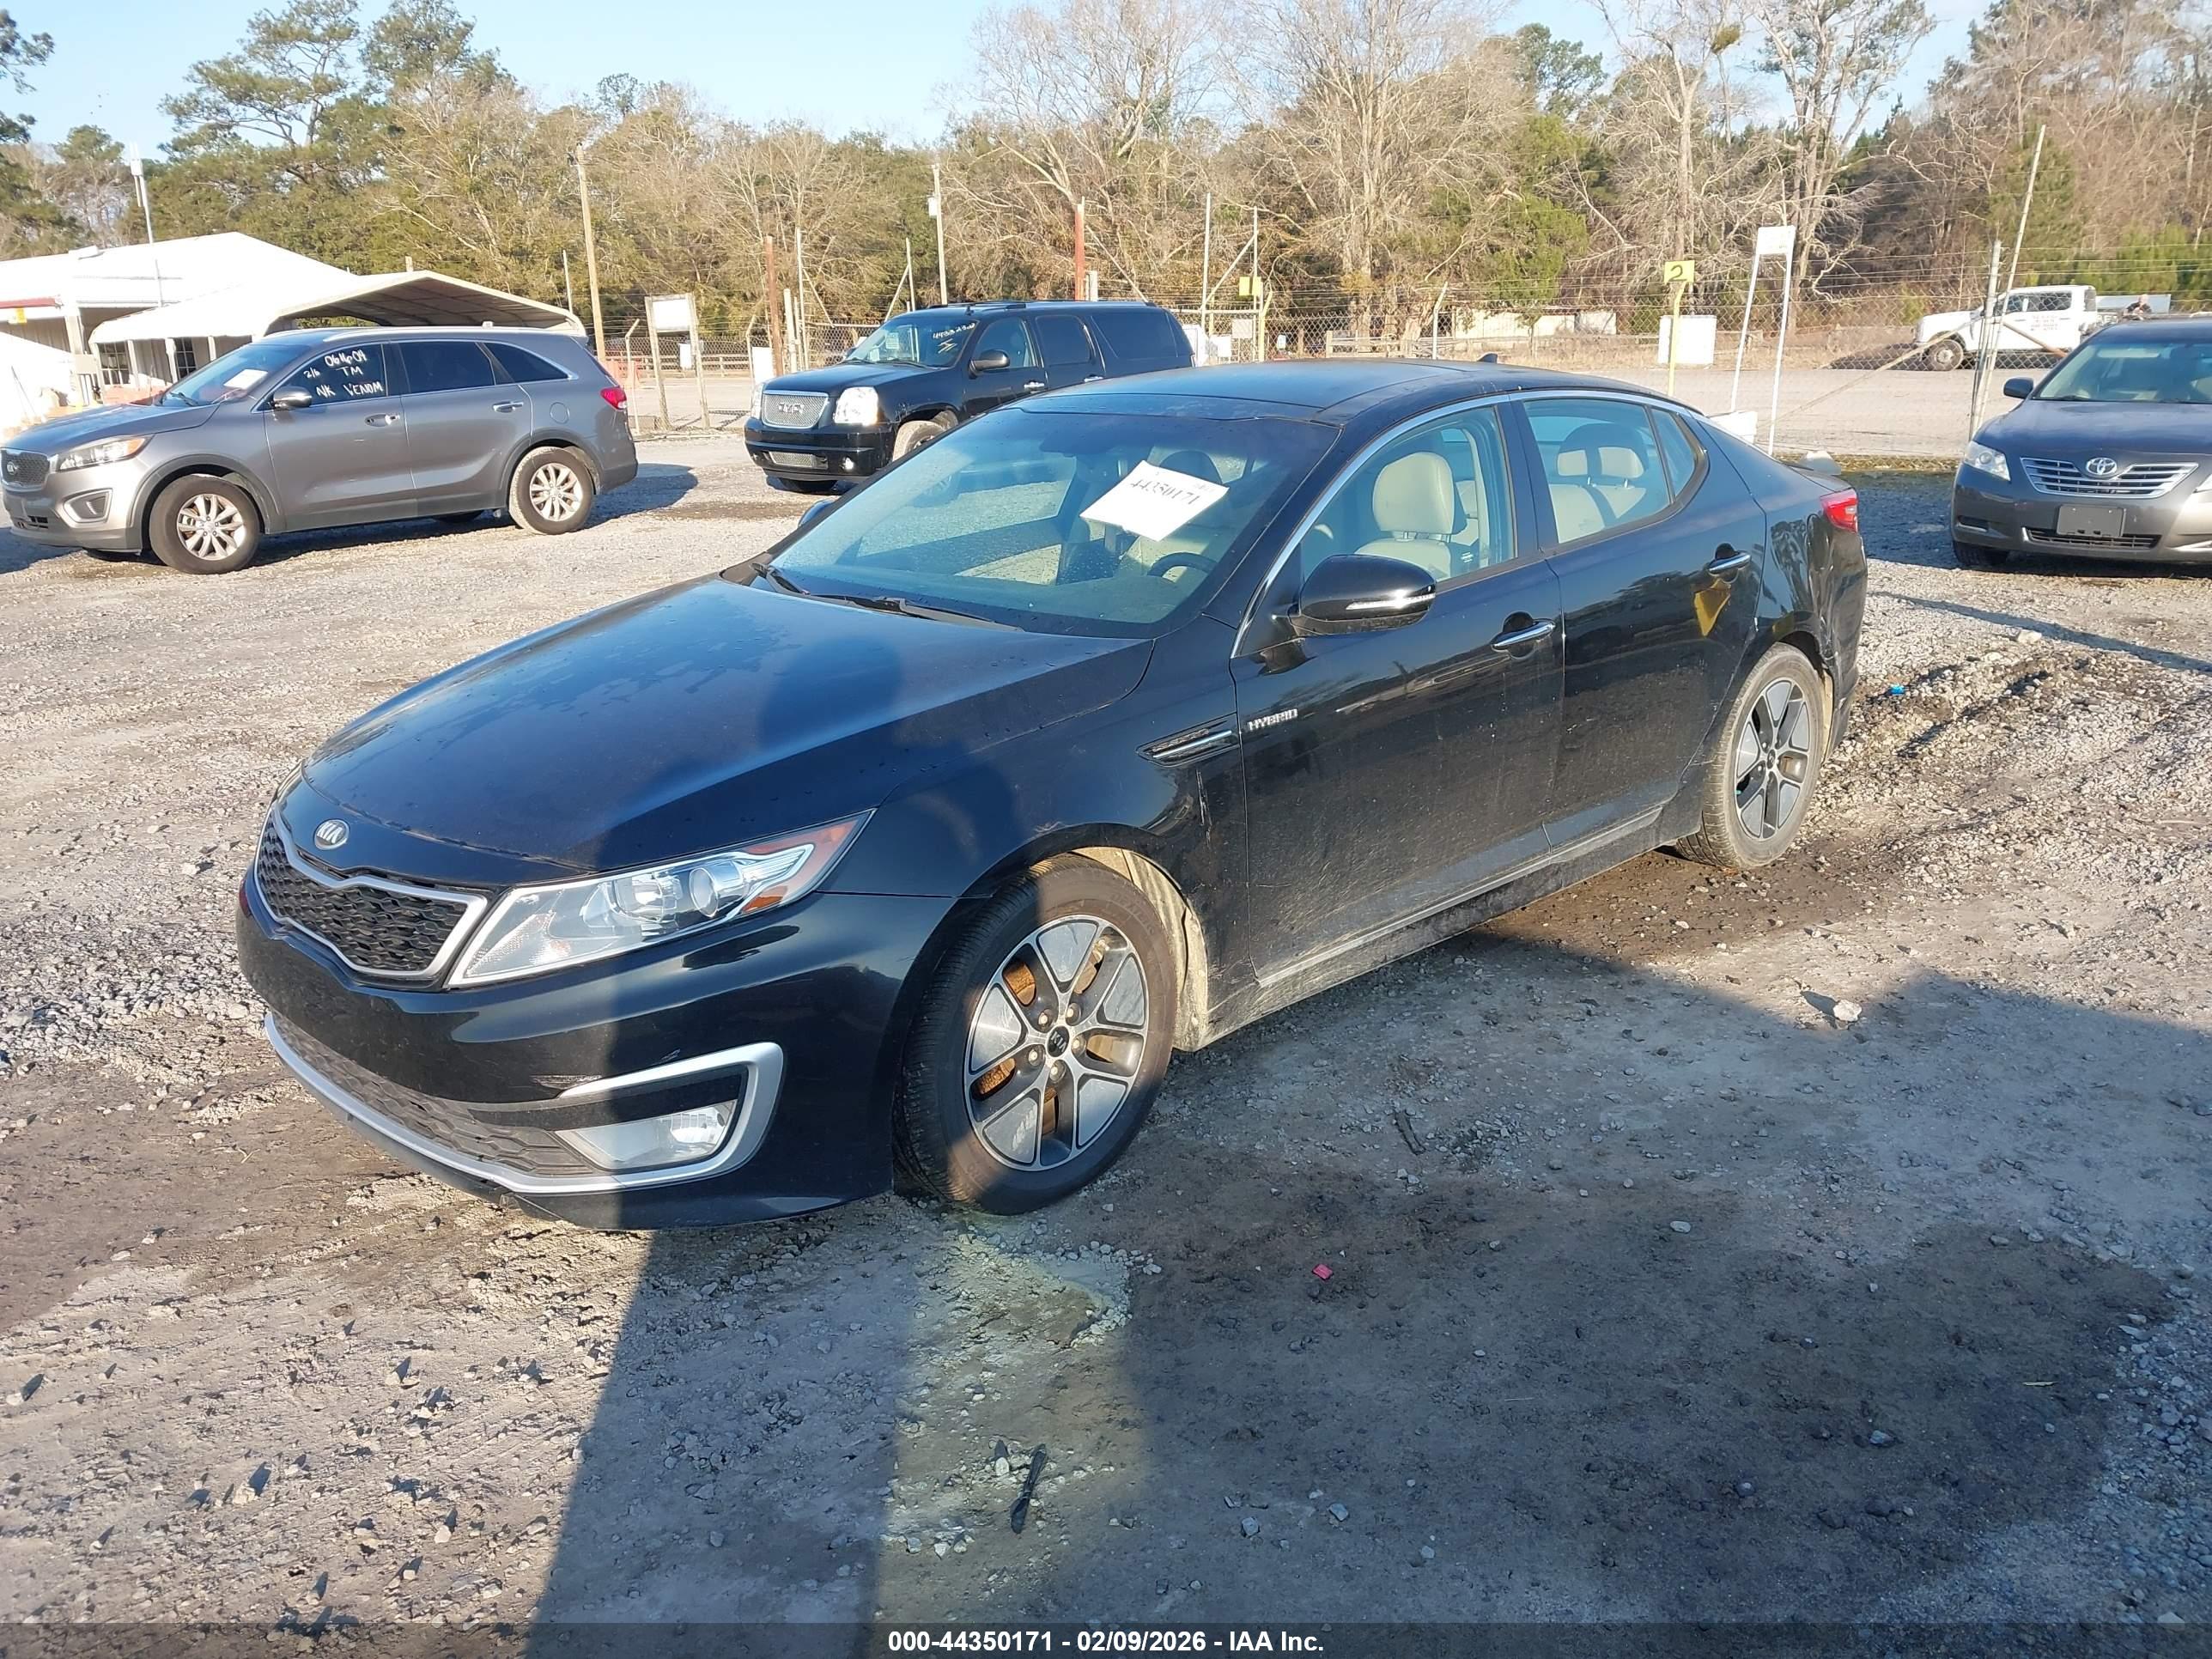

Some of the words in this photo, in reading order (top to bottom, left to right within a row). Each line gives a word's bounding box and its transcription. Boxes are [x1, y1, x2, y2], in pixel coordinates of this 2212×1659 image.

[1668, 264, 1687, 282] 2
[336, 366, 363, 376] TM
[1248, 708, 1298, 731] HYBRID
[1050, 1030, 1067, 1053] KIA
